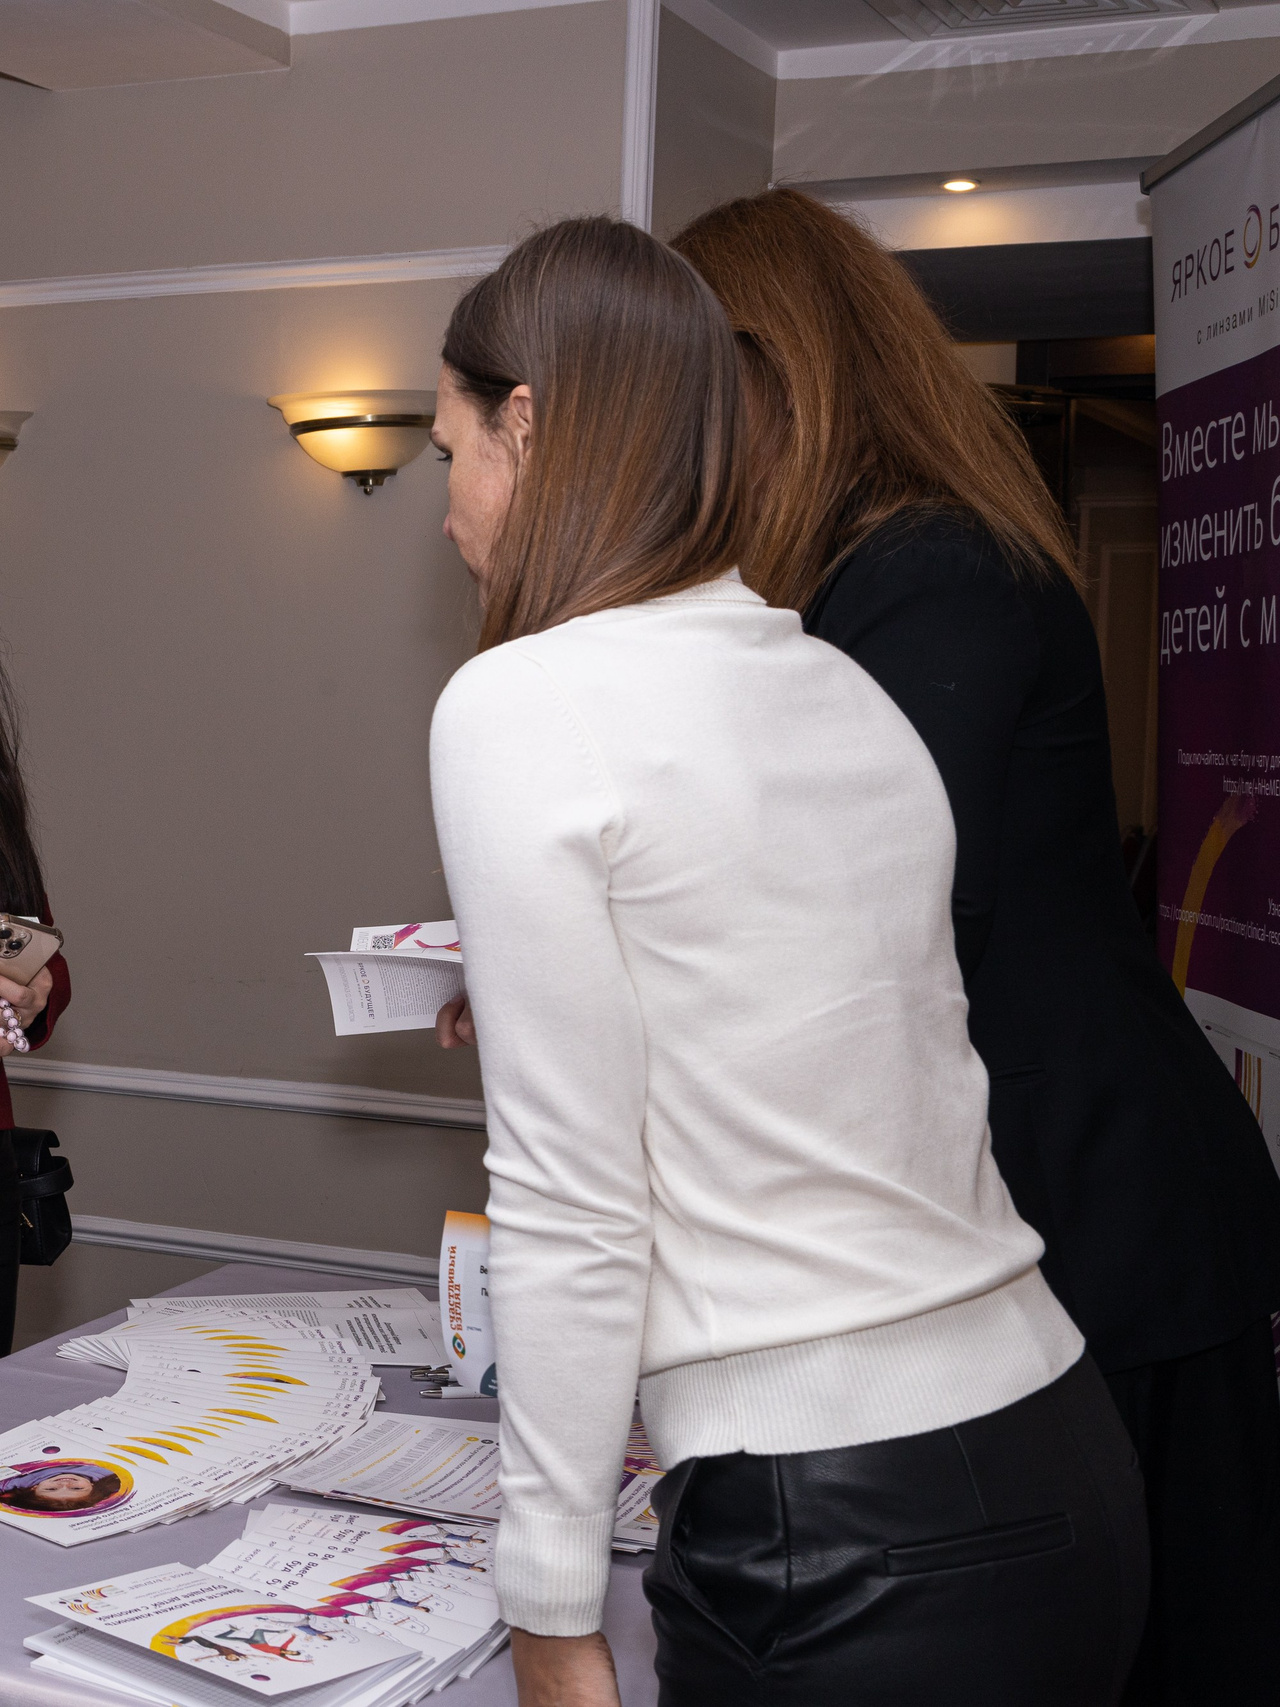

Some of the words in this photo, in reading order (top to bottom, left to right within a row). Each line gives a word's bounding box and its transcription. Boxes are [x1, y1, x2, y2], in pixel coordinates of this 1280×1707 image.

[1171, 229, 1235, 303] ЯРКОЕ
[1196, 329, 1202, 345] с
[1206, 306, 1253, 342] линзами
[1162, 411, 1246, 482] Вместе
[1161, 502, 1263, 569] изменить
[1160, 585, 1227, 665] детей
[1240, 598, 1251, 648] с
[447, 1245, 457, 1331] счастливый
[454, 1283, 463, 1331] взгляд
